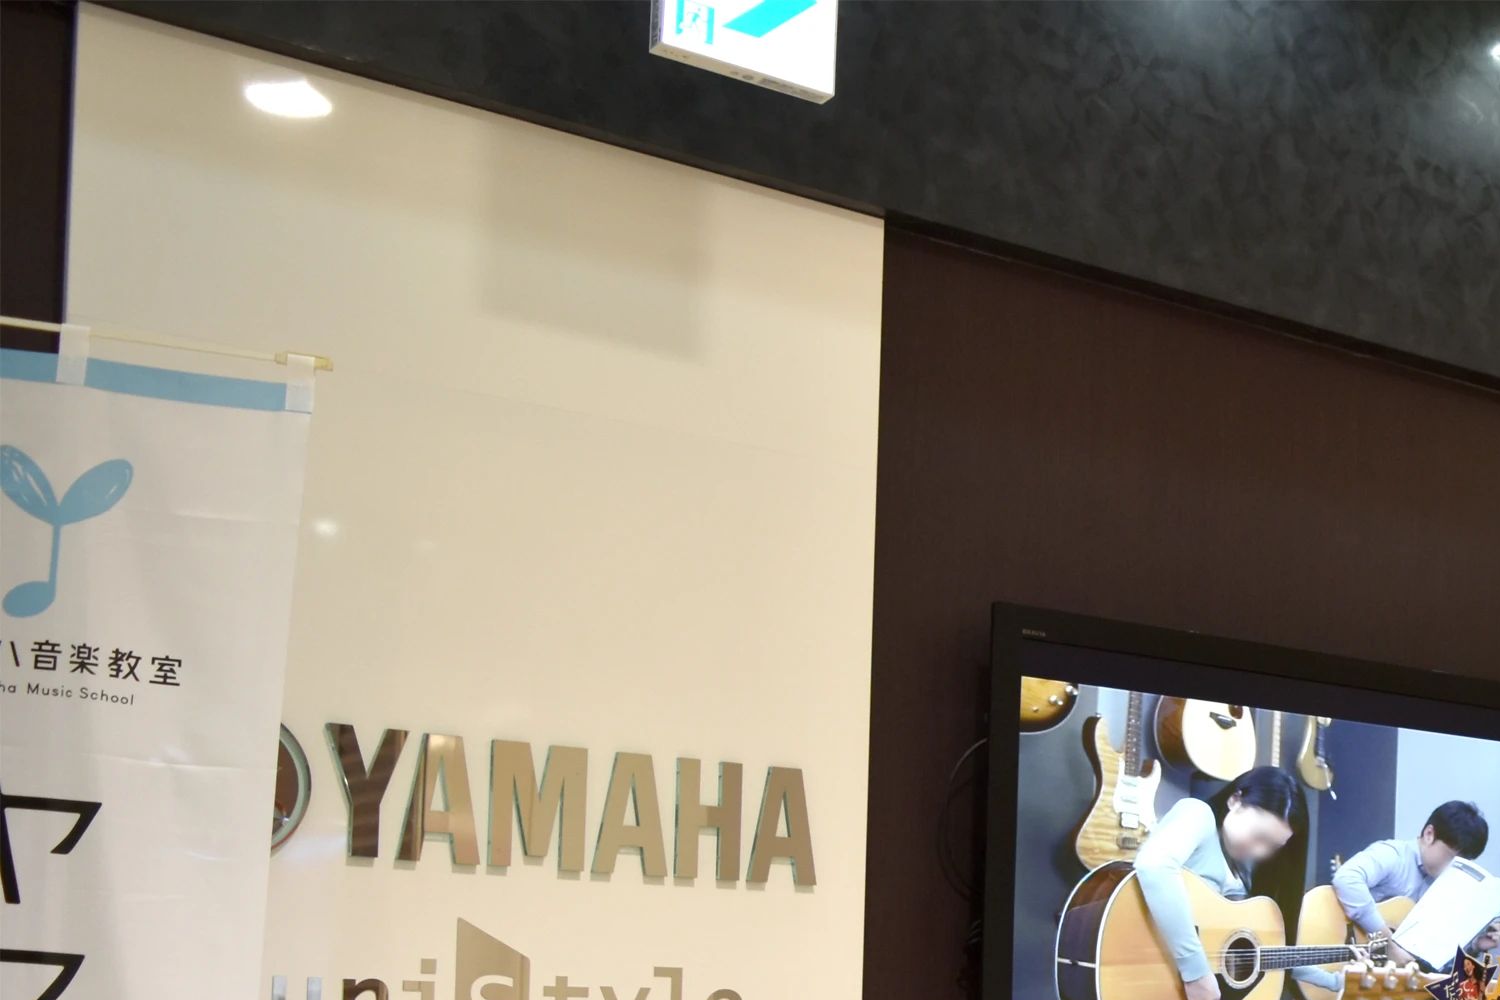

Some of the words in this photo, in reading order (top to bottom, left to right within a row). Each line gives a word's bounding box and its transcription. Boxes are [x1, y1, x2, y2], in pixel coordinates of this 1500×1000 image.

[27, 683, 73, 698] Music
[79, 687, 134, 706] School
[325, 722, 818, 886] YAMAHA
